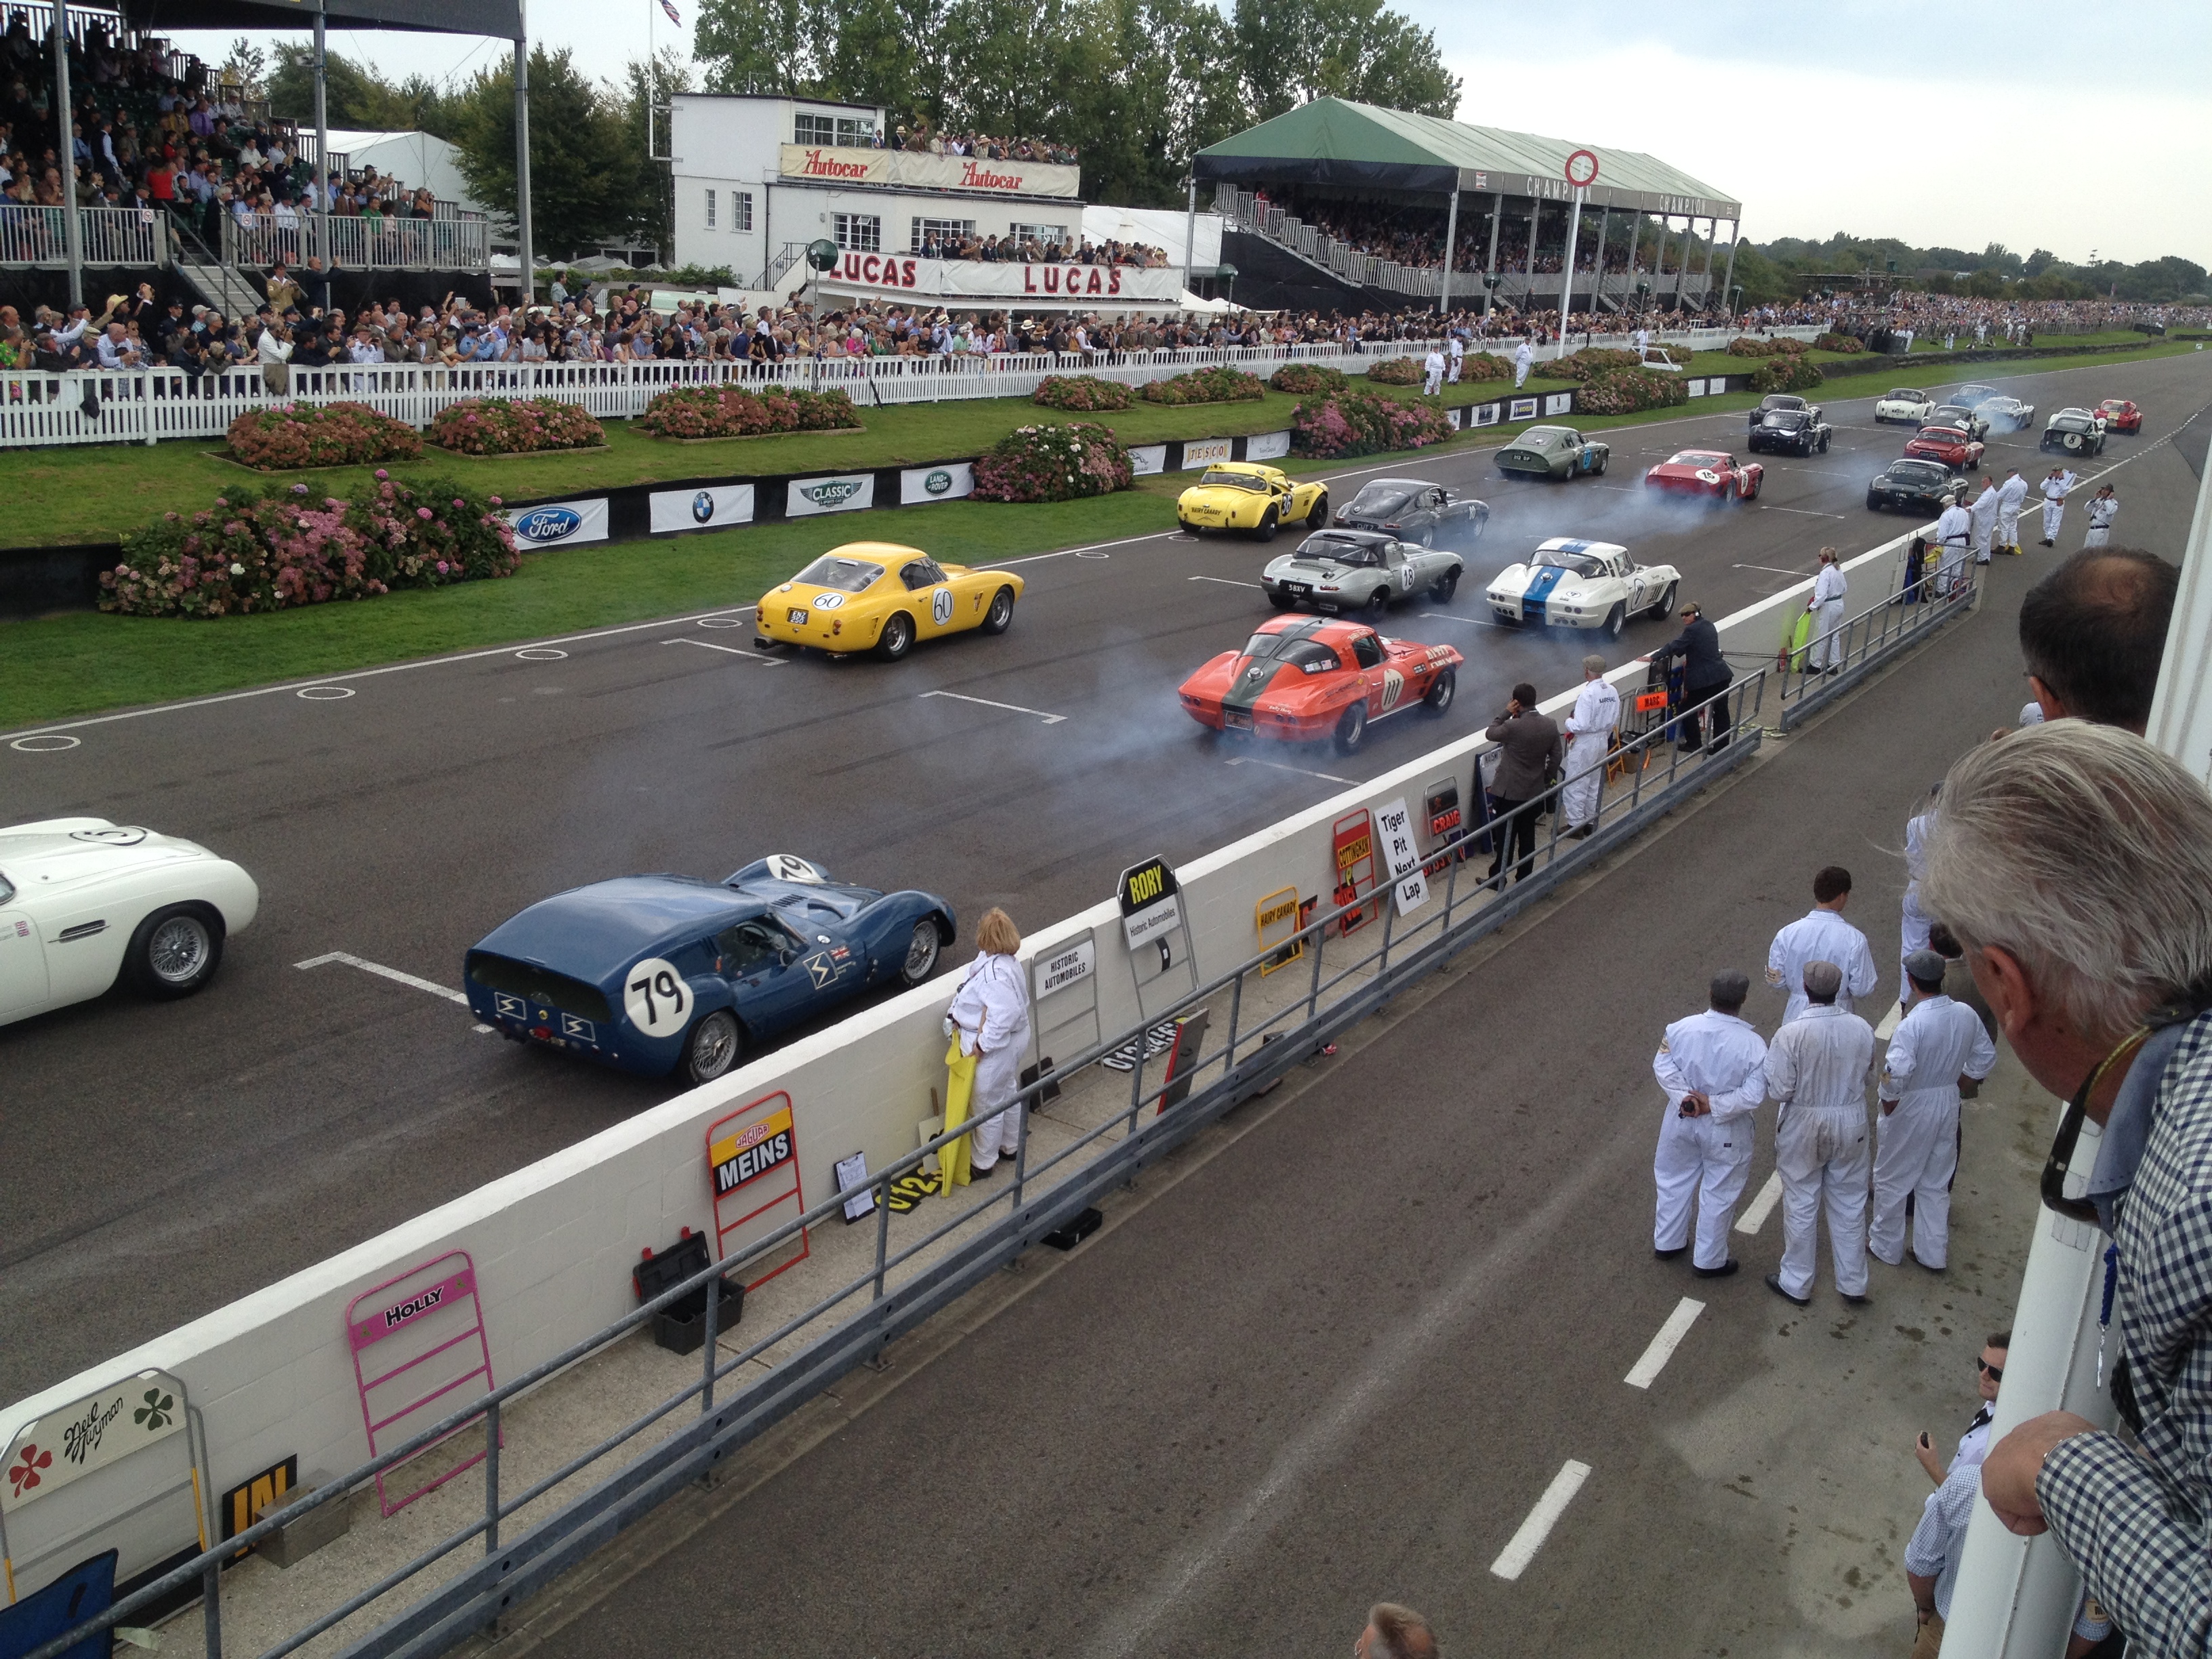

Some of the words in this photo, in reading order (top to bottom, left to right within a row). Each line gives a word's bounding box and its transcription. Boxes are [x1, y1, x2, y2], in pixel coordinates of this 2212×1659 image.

[802, 149, 867, 178] Autocar
[958, 161, 1022, 189] Autocar
[1659, 194, 1706, 215] CHAMPION
[1024, 265, 1122, 295] LUCAS
[2068, 435, 2076, 444] 8
[1190, 445, 1225, 460] TESCO
[930, 474, 944, 483] LAND
[930, 481, 948, 491] ROVER
[694, 492, 712, 503] BMW
[813, 485, 851, 501] CLASSIC
[1282, 495, 1292, 514] 36
[529, 512, 570, 537] Ford
[1404, 568, 1414, 587] 18
[814, 594, 843, 609] 60
[934, 591, 953, 621] 60
[1644, 695, 1660, 707] MARC
[1381, 811, 1405, 832] Tiger
[1433, 810, 1461, 834] CRAIG
[1393, 836, 1408, 856] Pit
[1128, 865, 1163, 905] RORY
[1403, 882, 1420, 901] Lap
[1130, 920, 1148, 937] Historic
[1148, 907, 1176, 928] Automobiles
[1050, 951, 1079, 972] HISTORIC
[1044, 962, 1086, 990] AUTOMOBILES
[631, 969, 684, 1025] 79
[737, 1126, 768, 1147] JAGUAR
[719, 1133, 788, 1191] MEINS
[385, 1287, 445, 1328] HOLLY
[64, 1401, 100, 1458] Neil
